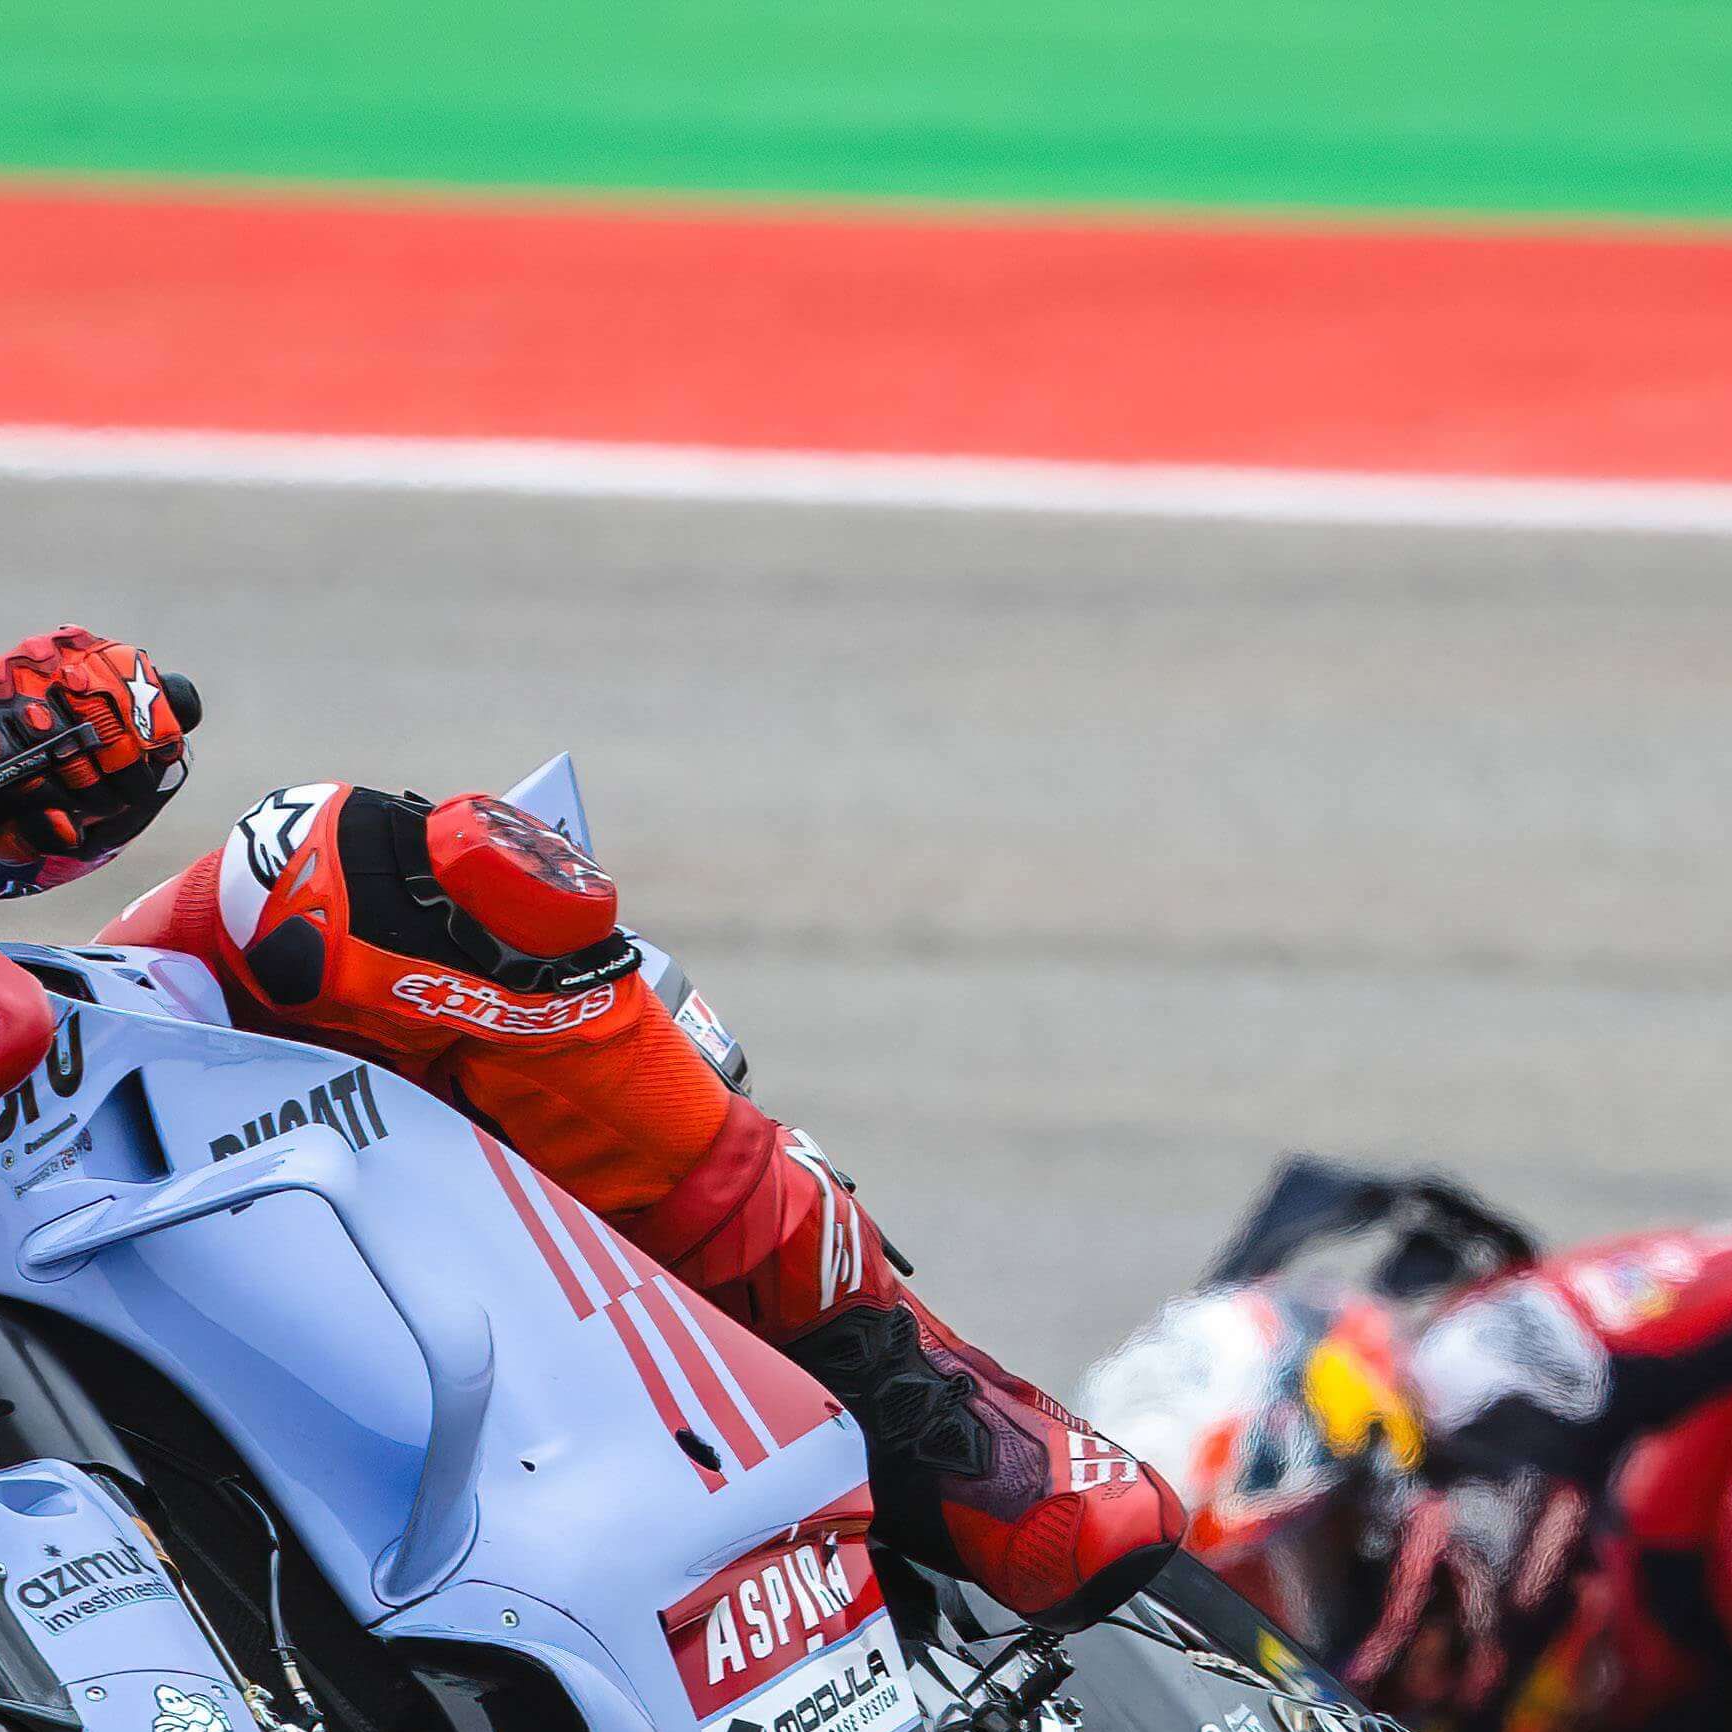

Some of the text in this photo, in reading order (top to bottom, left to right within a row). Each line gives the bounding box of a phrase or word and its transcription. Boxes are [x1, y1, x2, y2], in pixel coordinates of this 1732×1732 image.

[17, 1537, 158, 1609] azimut
[706, 1544, 855, 1686] ASPIRA
[860, 1684, 900, 1726] SYSTEM
